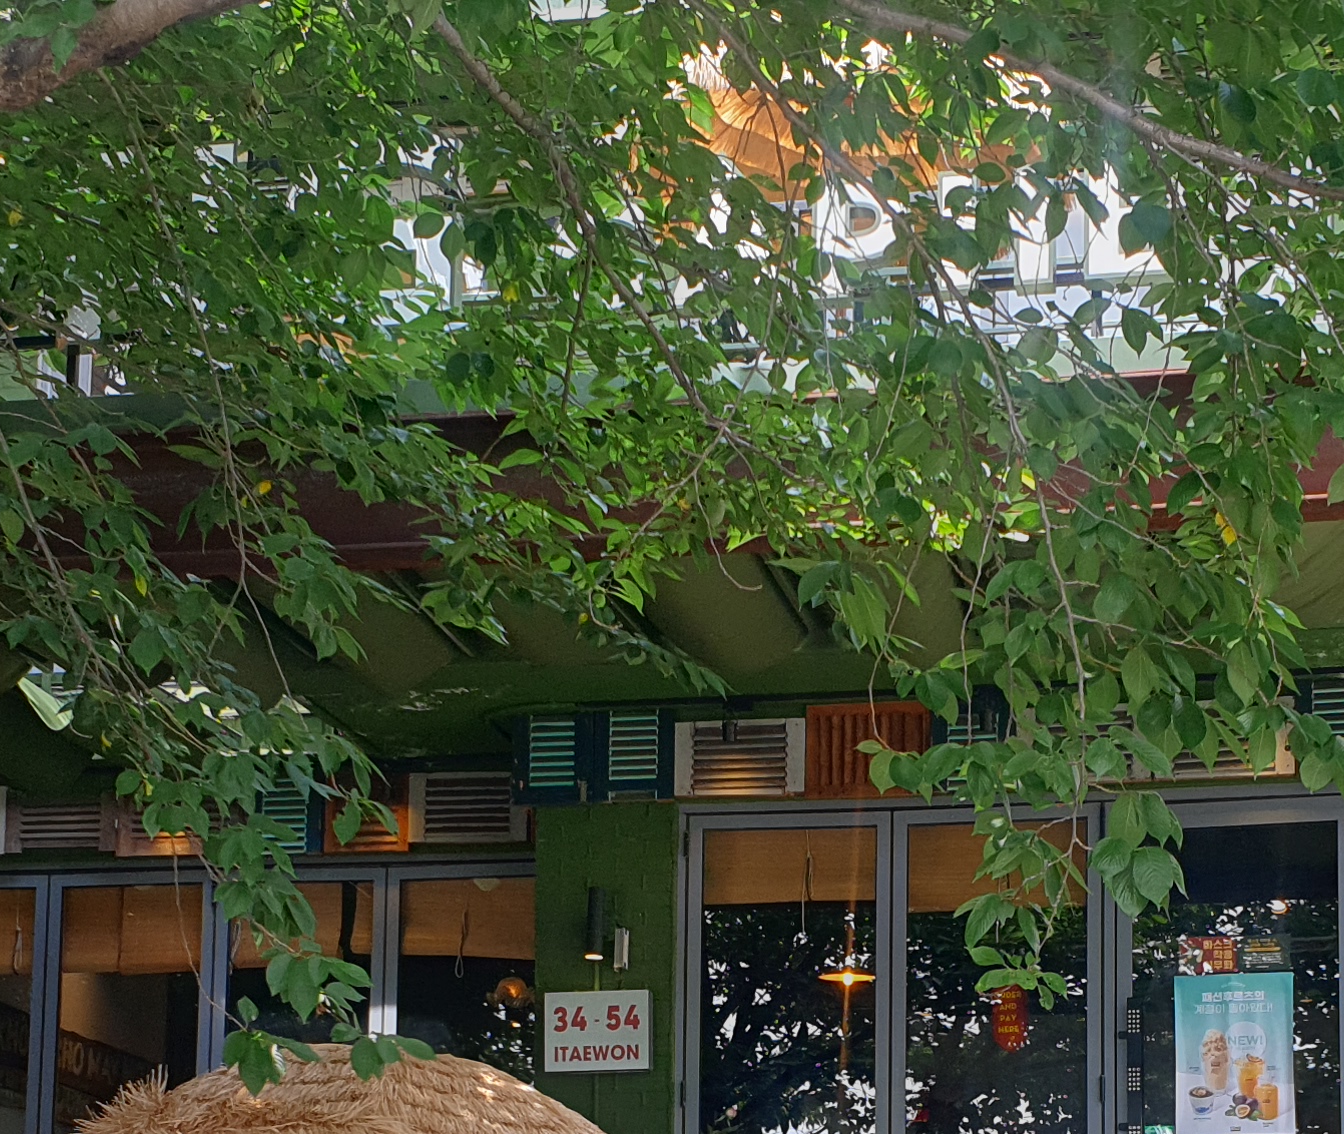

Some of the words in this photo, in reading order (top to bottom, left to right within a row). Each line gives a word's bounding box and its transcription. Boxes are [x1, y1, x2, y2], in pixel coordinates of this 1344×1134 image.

[553, 1006, 587, 1032] 34
[606, 1004, 640, 1031] 54
[998, 1025, 1019, 1033] HERE
[1227, 1035, 1263, 1046] NEW!
[554, 1044, 640, 1062] ITAEWON
